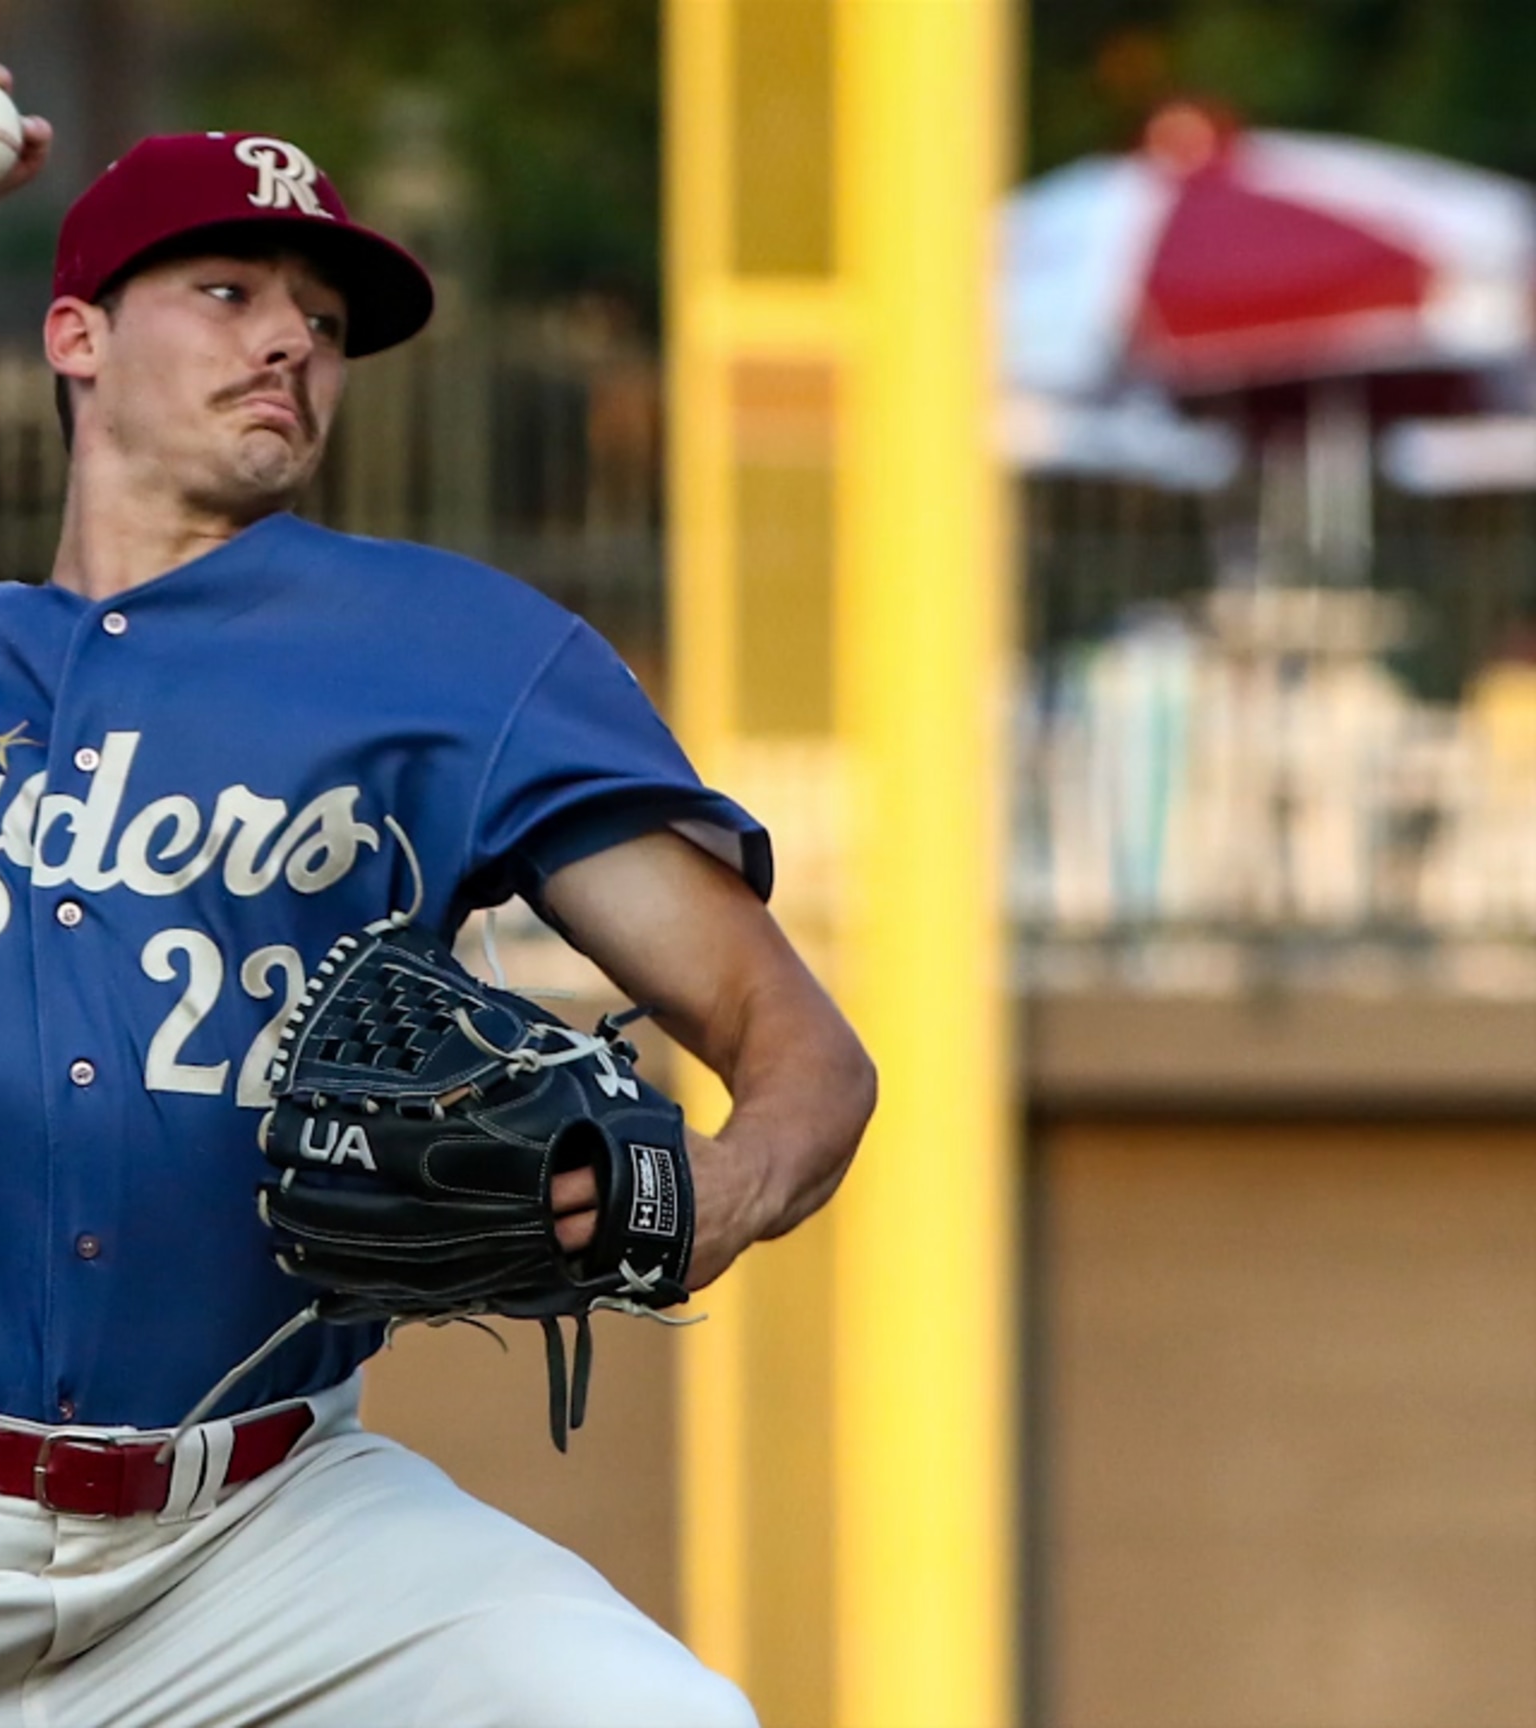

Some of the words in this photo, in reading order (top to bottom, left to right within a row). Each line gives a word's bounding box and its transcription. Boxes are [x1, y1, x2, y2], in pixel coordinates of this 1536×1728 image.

[234, 136, 335, 219] R
[140, 927, 307, 1108] 22
[300, 1117, 377, 1172] UA
